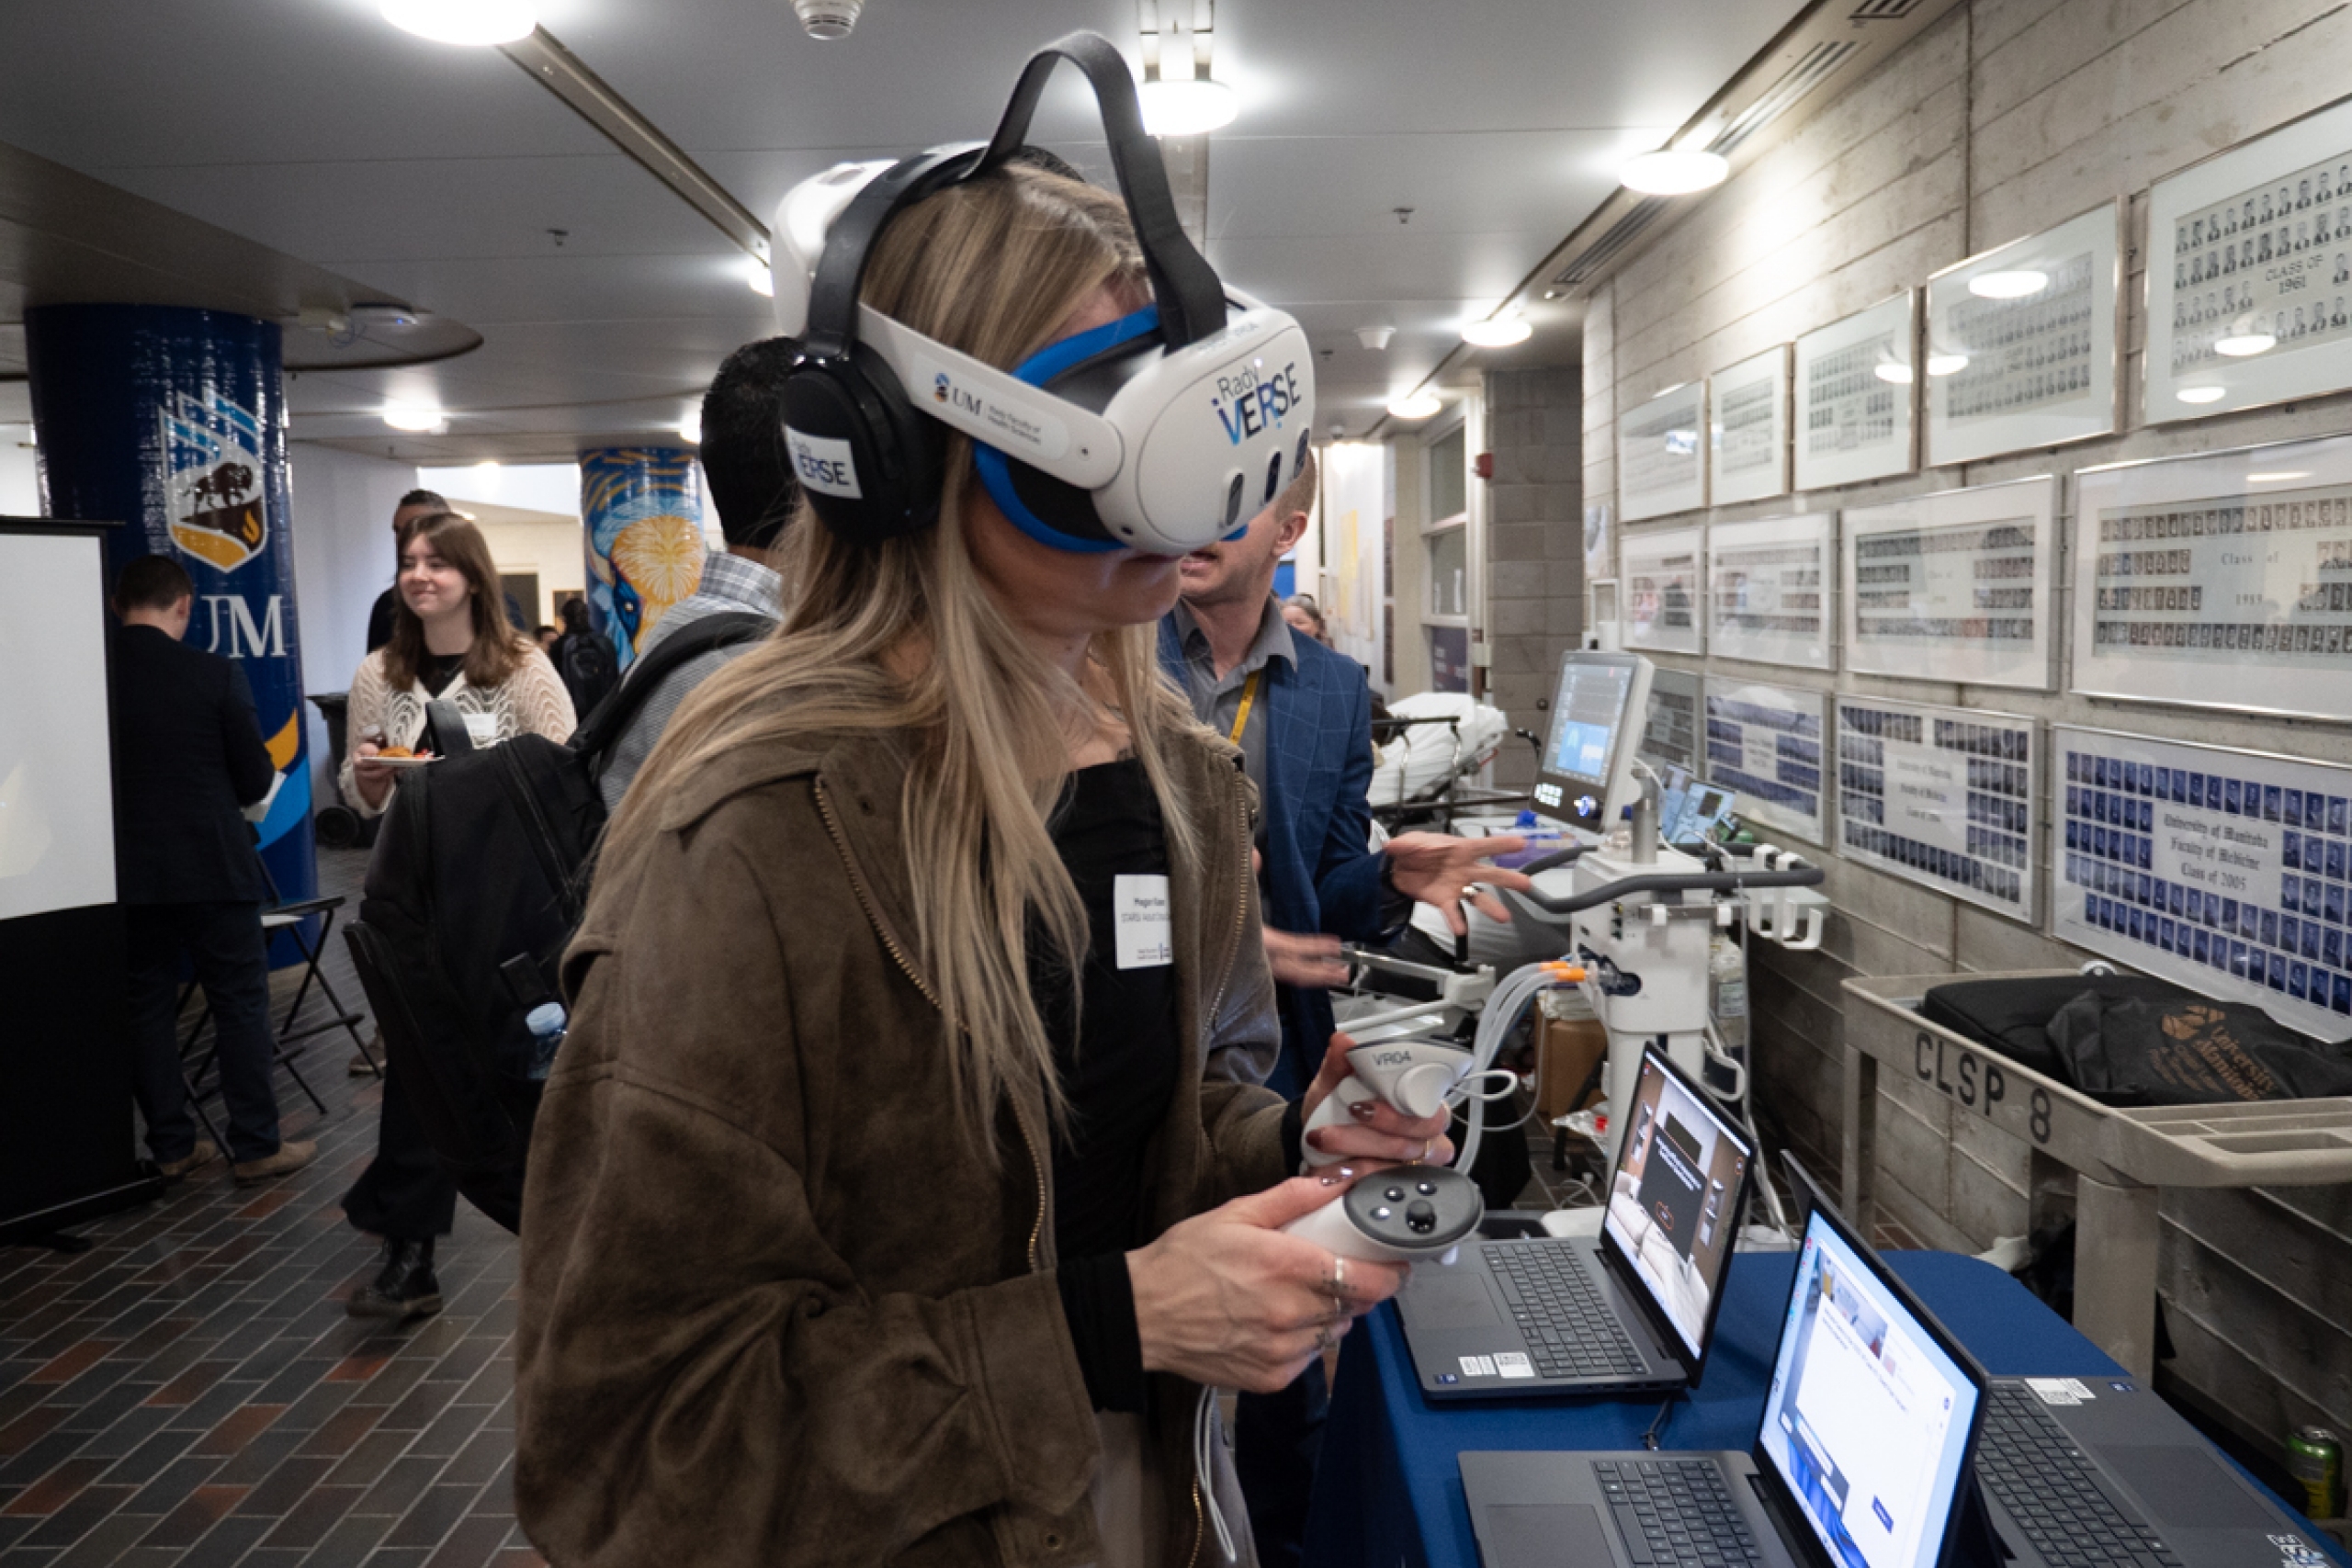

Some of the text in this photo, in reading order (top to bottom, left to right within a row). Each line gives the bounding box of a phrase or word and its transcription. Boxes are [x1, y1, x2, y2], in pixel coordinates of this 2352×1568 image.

[2264, 254, 2324, 282] CLASS OF
[2278, 276, 2307, 296] 1961
[1216, 365, 1259, 401] Rady
[953, 387, 981, 416] UM
[1213, 361, 1302, 446] VERSE
[2221, 552, 2253, 566] Class
[2164, 813, 2268, 849] University of Manitoba
[2170, 837, 2260, 871] Faculty of Medicine
[2181, 862, 2204, 881] Class
[2208, 870, 2217, 885] of
[2211, 1025, 2275, 1094] University
[1915, 1032, 2051, 1145] CLSP 8
